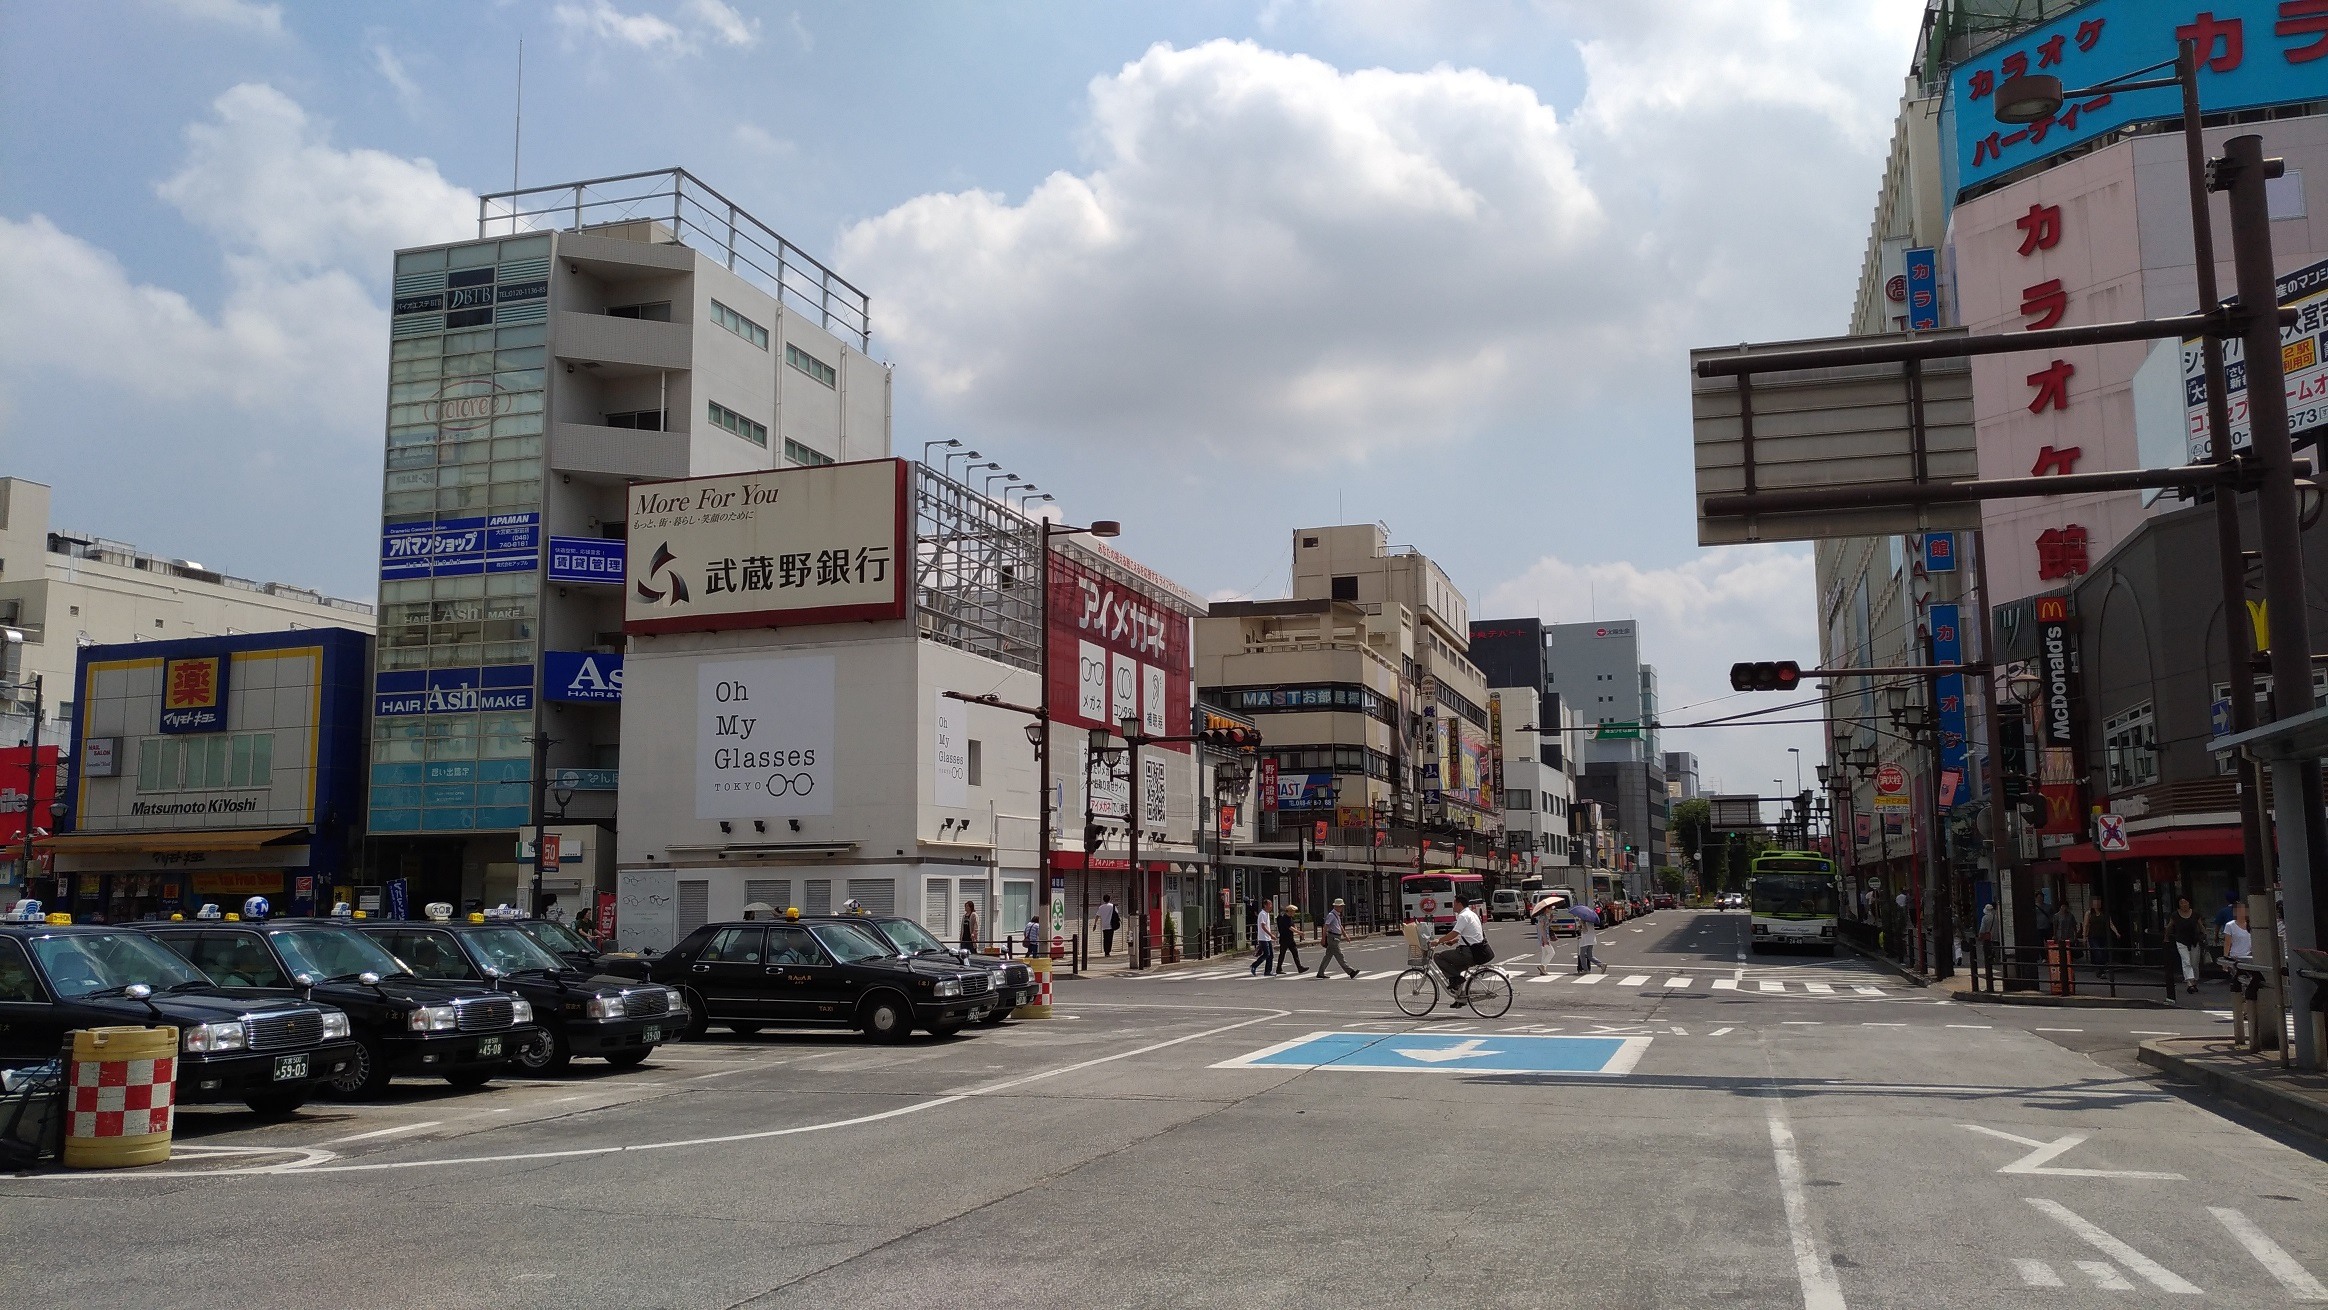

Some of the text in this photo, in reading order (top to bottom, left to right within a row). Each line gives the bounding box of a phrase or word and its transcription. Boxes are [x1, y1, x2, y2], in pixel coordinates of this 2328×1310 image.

[1968, 18, 2105, 100] カラオケ
[634, 484, 779, 515] More For You
[490, 515, 529, 526] APAMAN
[390, 531, 478, 557] アパマンショップ
[555, 555, 622, 573] 賃貸管理
[705, 546, 890, 595] 武蔵野銀行
[404, 605, 521, 624] HAIR Ash MAKE
[1079, 576, 1166, 658] アイメガネ
[173, 662, 210, 704] 薬
[716, 681, 749, 702] Oh
[2046, 626, 2071, 740] McDonald's
[382, 683, 527, 713] HAIR Ash MAKE
[1083, 694, 1102, 711] メガネ
[164, 711, 216, 727] マツモトキヨシ
[716, 714, 756, 739] My
[938, 716, 948, 728] Oh
[939, 733, 950, 748] My
[714, 749, 816, 770] Glasses
[939, 750, 964, 765] Glasses
[714, 781, 761, 791] TOKYO
[1265, 764, 1276, 805] 野村證券
[1879, 775, 1902, 785] 消火栓
[131, 798, 257, 815] Matsumoto KiYoshi
[545, 844, 556, 860] 50
[483, 1044, 502, 1056] 45-08
[280, 1063, 307, 1079] 59-03
